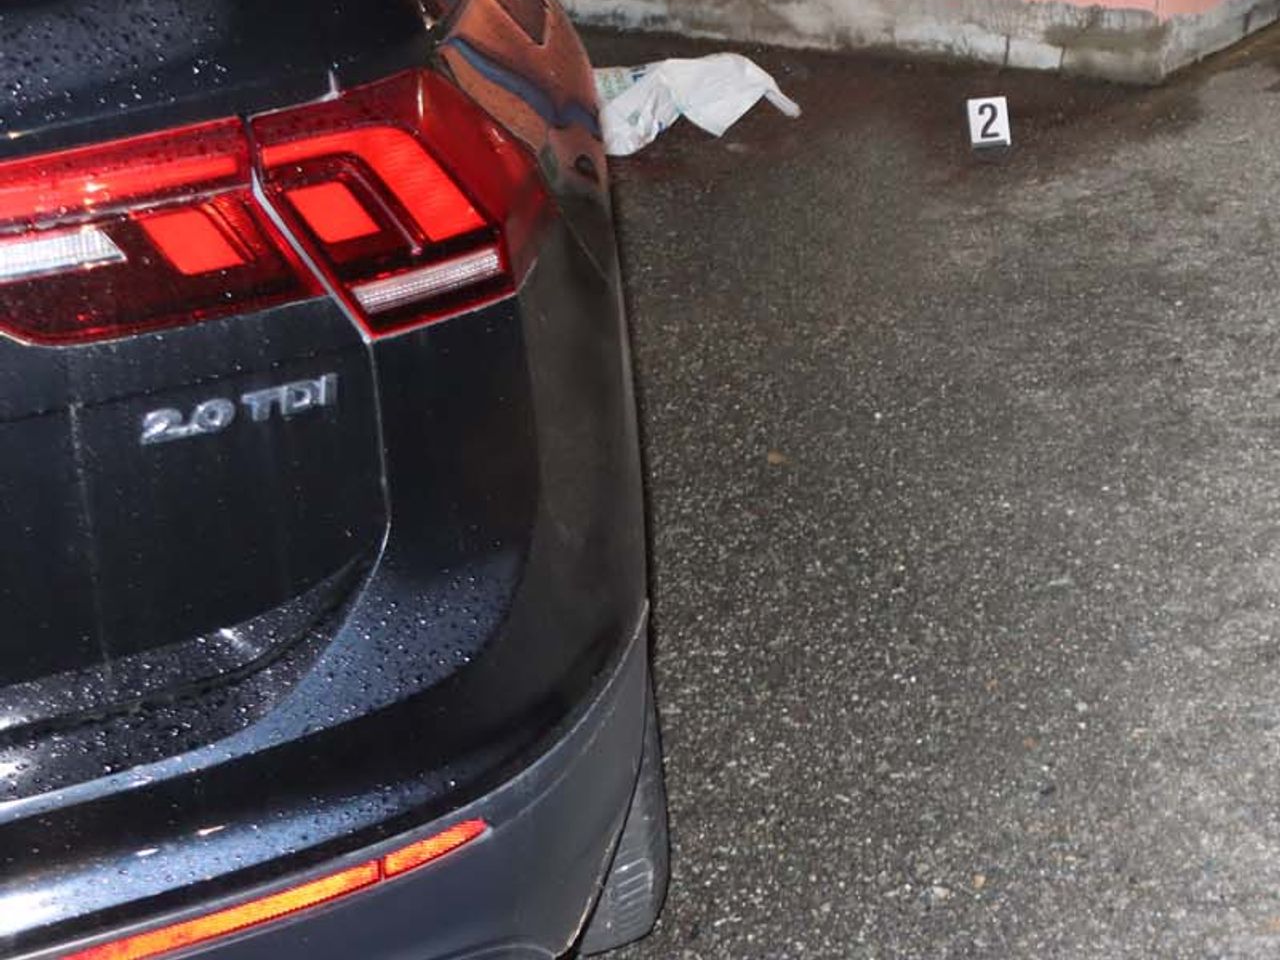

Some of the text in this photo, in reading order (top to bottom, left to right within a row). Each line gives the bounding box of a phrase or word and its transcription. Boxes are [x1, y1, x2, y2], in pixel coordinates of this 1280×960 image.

[978, 102, 999, 138] 2
[140, 372, 339, 445] 2.0 TDI
